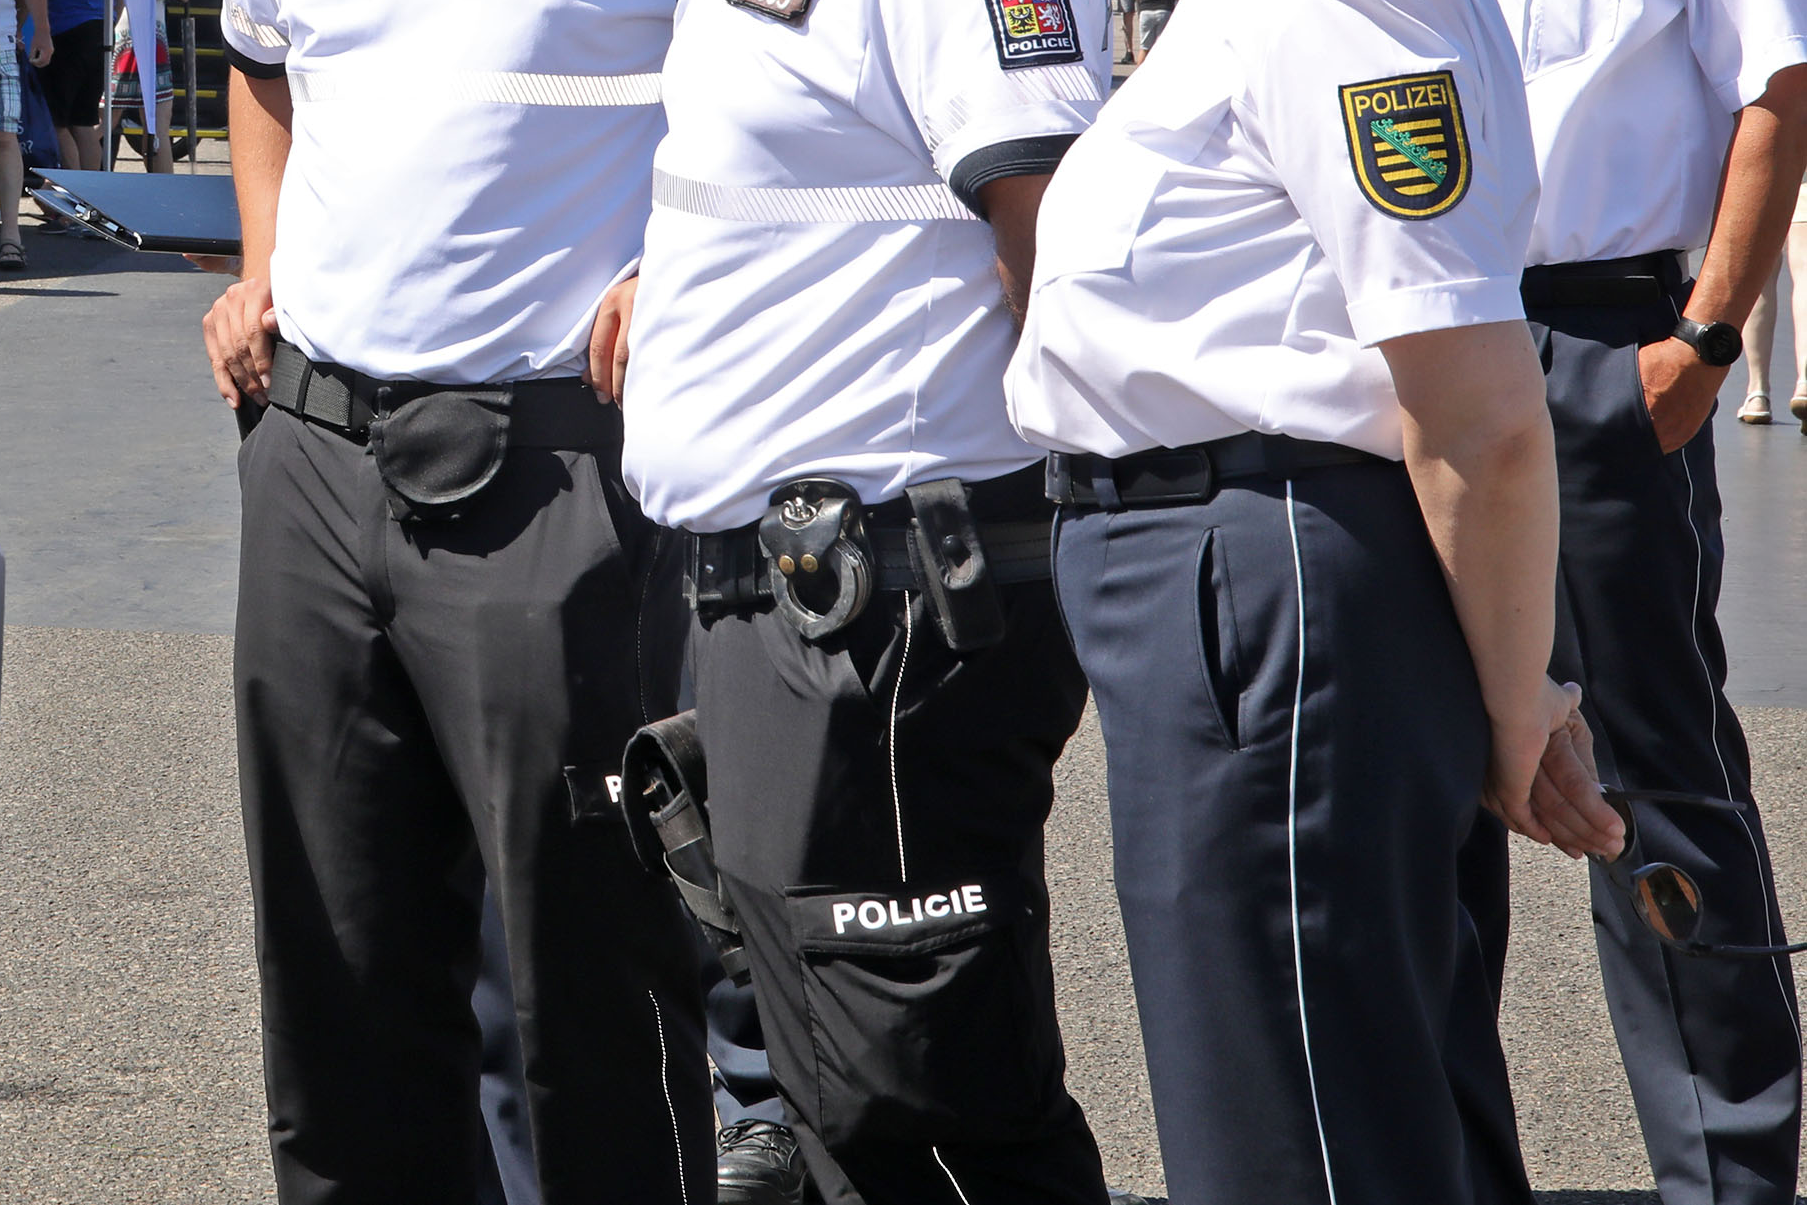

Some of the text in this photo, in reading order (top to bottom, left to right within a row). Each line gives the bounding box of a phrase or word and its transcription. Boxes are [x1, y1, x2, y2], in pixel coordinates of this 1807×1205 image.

[1008, 37, 1071, 53] POLICIE
[1354, 84, 1448, 117] POLIZEI
[832, 885, 987, 935] POLICIE
